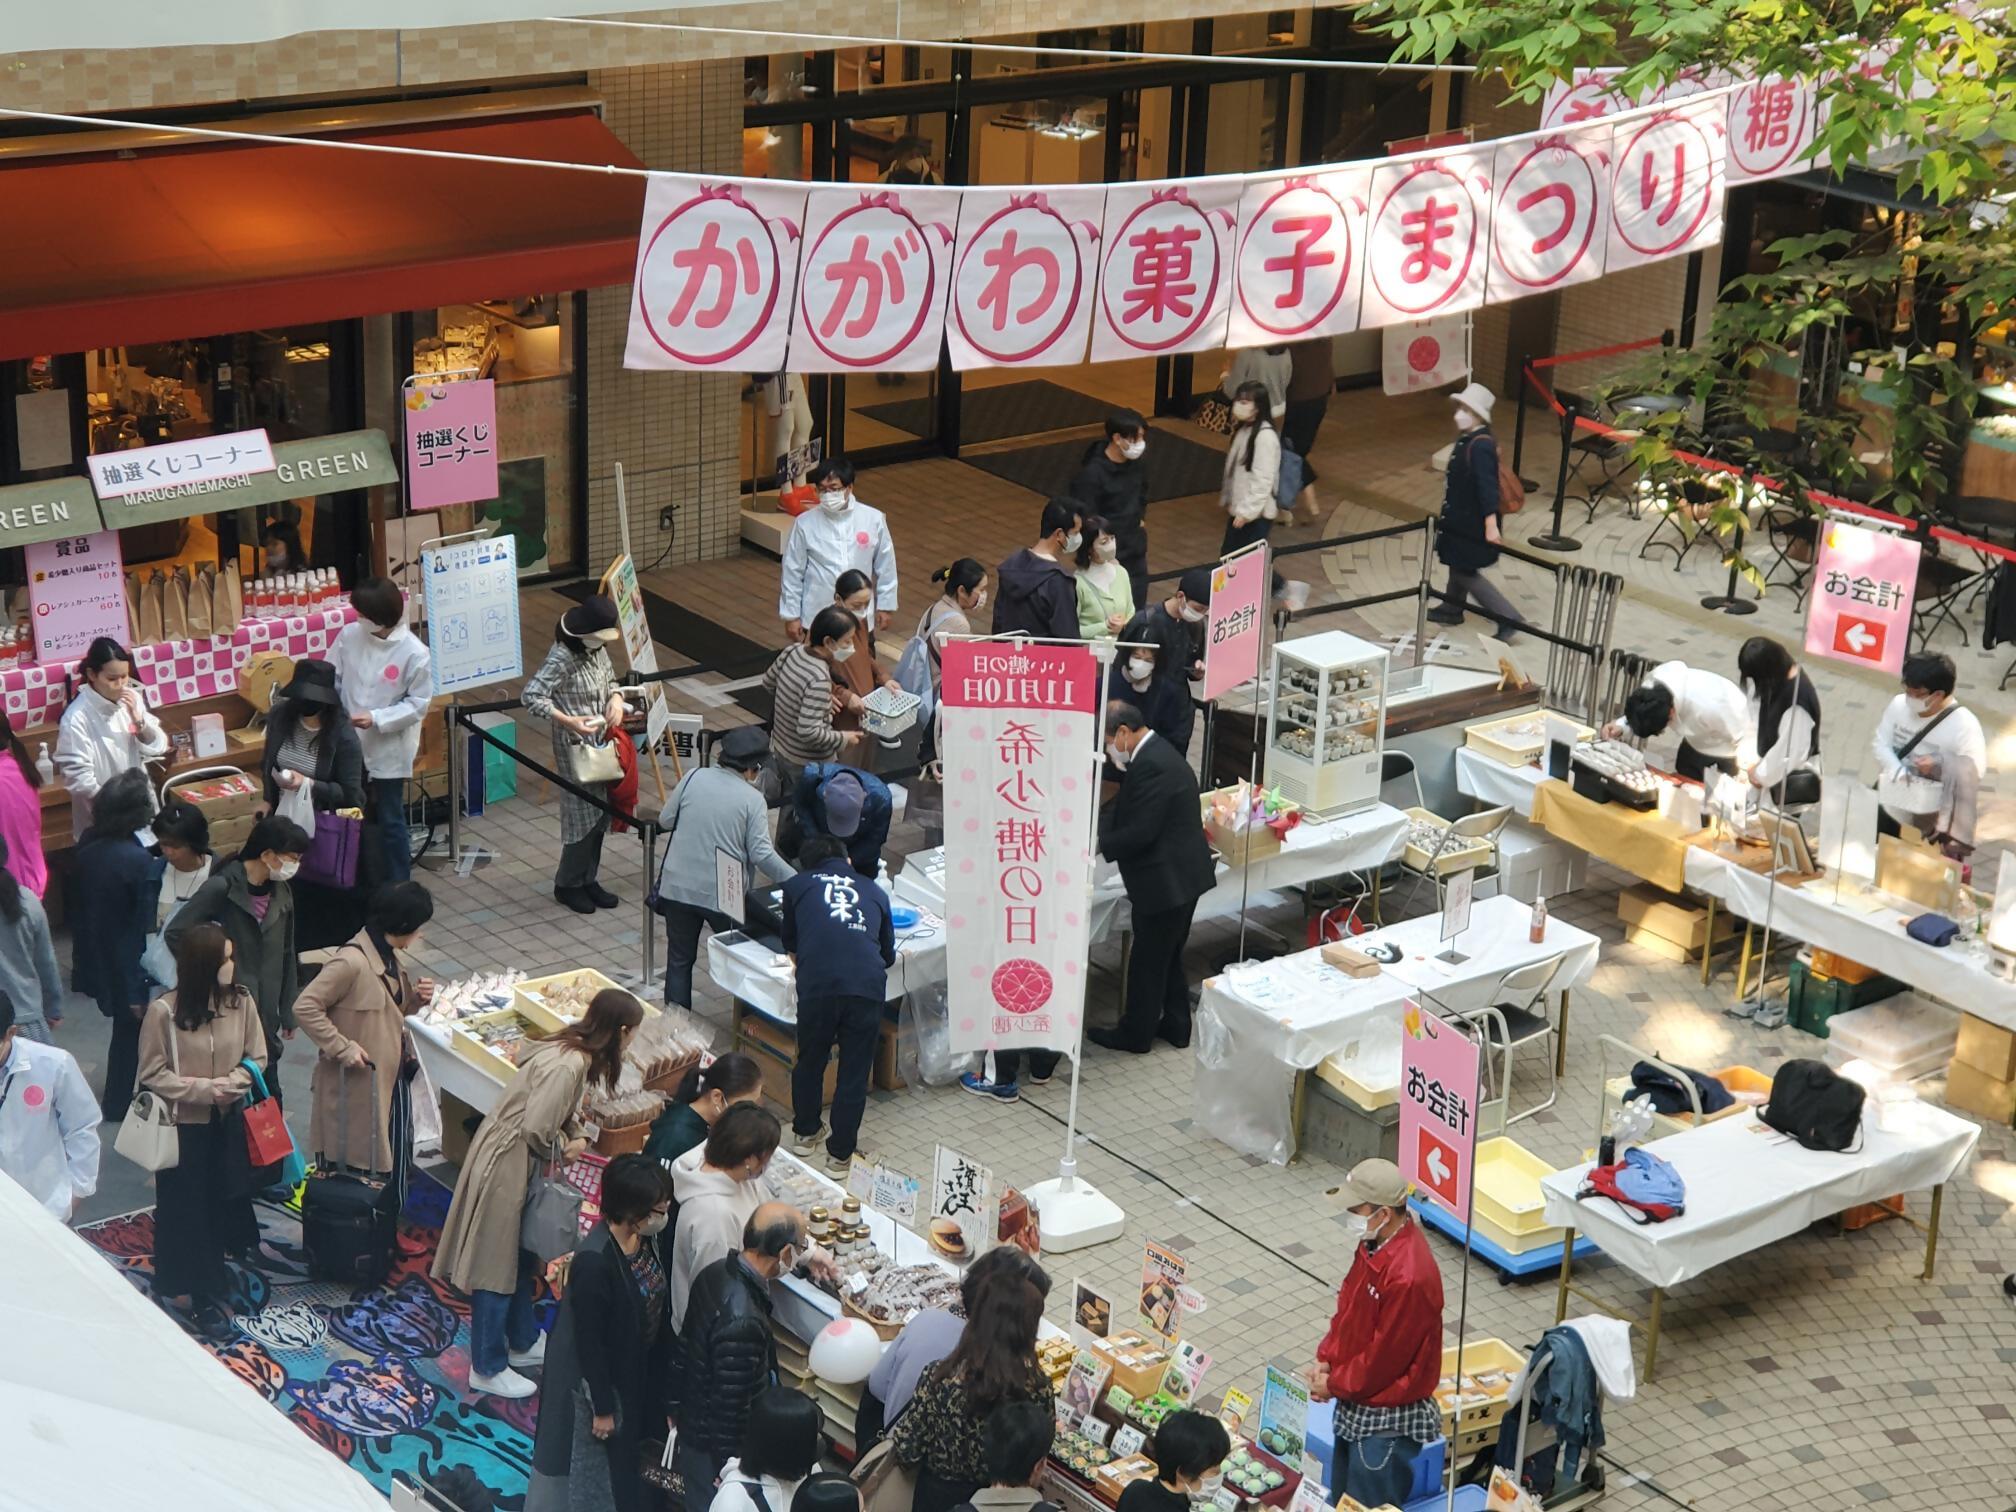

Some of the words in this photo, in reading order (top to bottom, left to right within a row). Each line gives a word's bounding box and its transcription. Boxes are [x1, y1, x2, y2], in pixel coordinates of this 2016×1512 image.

[416, 424, 488, 450] 抽選くじ
[102, 446, 263, 487] 抽選くじコーナー
[276, 450, 370, 484] GREEN
[419, 446, 489, 467] コーナー
[124, 473, 252, 506] MARUGAMEMACHI
[56, 537, 90, 558] 賞品
[1824, 570, 1905, 611] お会計
[1213, 602, 1256, 644] お会計
[1407, 1066, 1470, 1136] お会計
